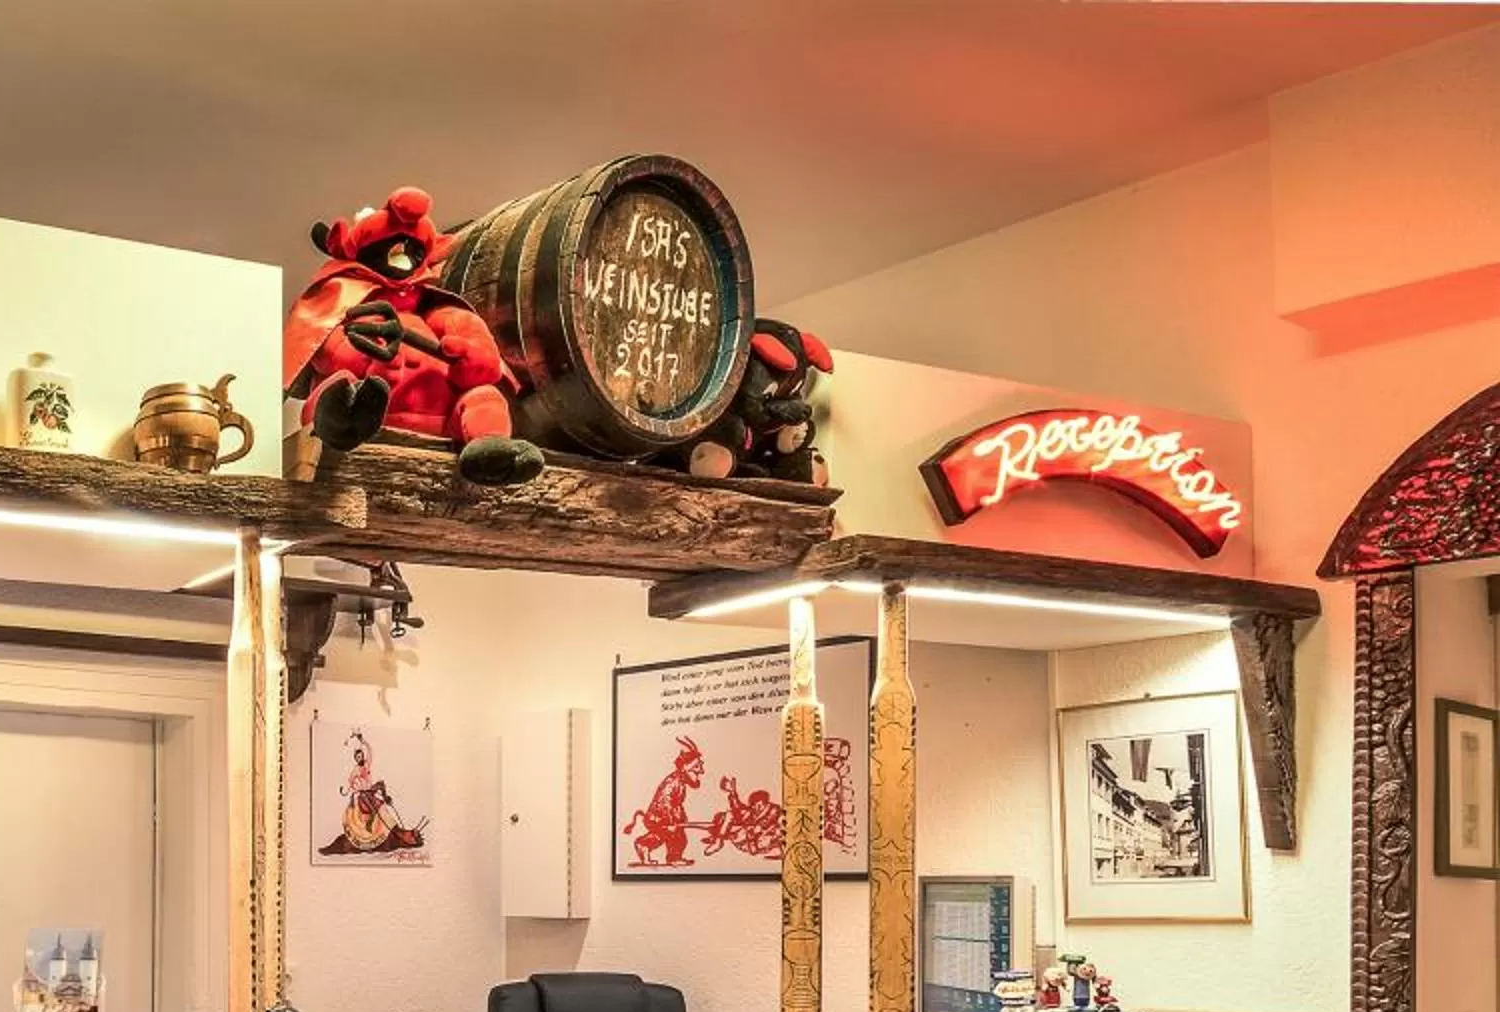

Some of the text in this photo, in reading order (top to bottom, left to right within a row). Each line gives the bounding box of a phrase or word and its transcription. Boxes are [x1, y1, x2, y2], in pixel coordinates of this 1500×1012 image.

[625, 213, 691, 269] ISA'S
[583, 259, 713, 327] WEINSTUBE
[623, 319, 674, 350] SEIT
[613, 343, 680, 386] 2017
[973, 415, 1242, 529] Reception
